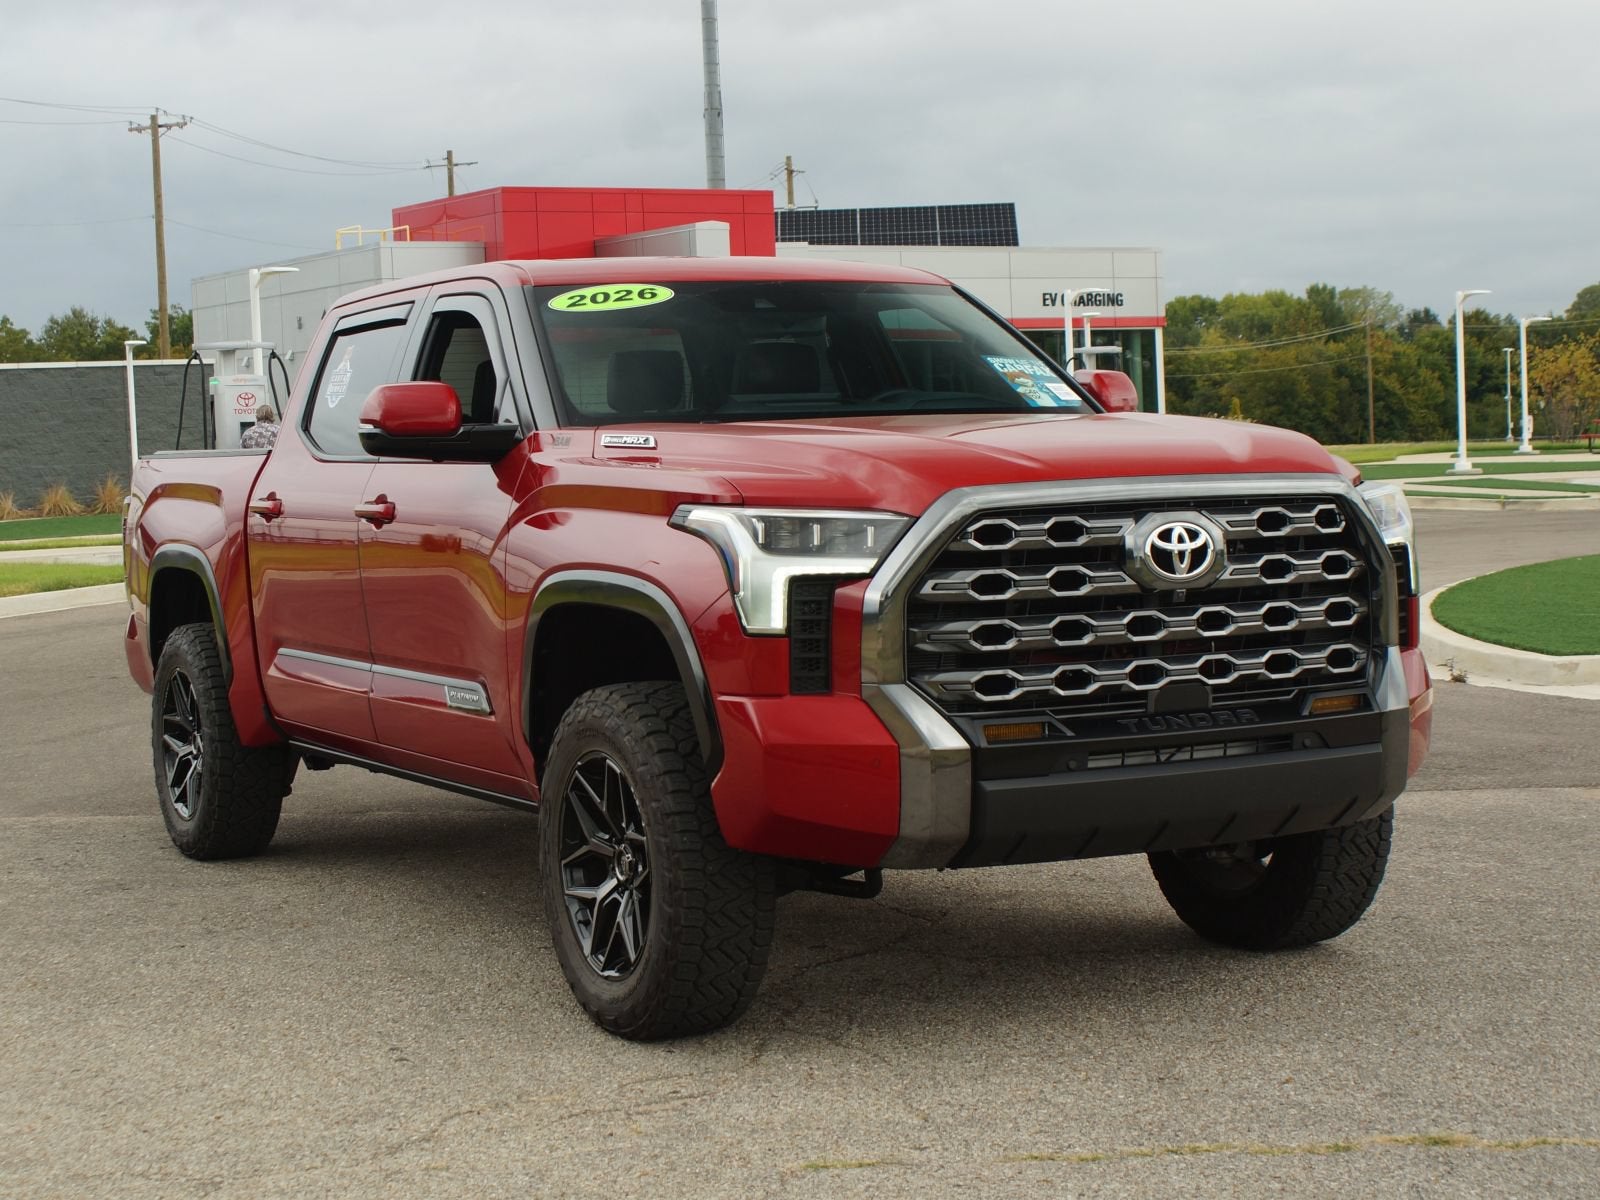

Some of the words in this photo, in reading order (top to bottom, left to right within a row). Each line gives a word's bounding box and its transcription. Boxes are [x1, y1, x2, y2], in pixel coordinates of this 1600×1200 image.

[566, 287, 658, 308] 2026
[1042, 292, 1058, 307] EV
[1061, 292, 1124, 307] ARGING
[622, 436, 648, 445] MAX
[1116, 708, 1261, 733] TUNDRA
